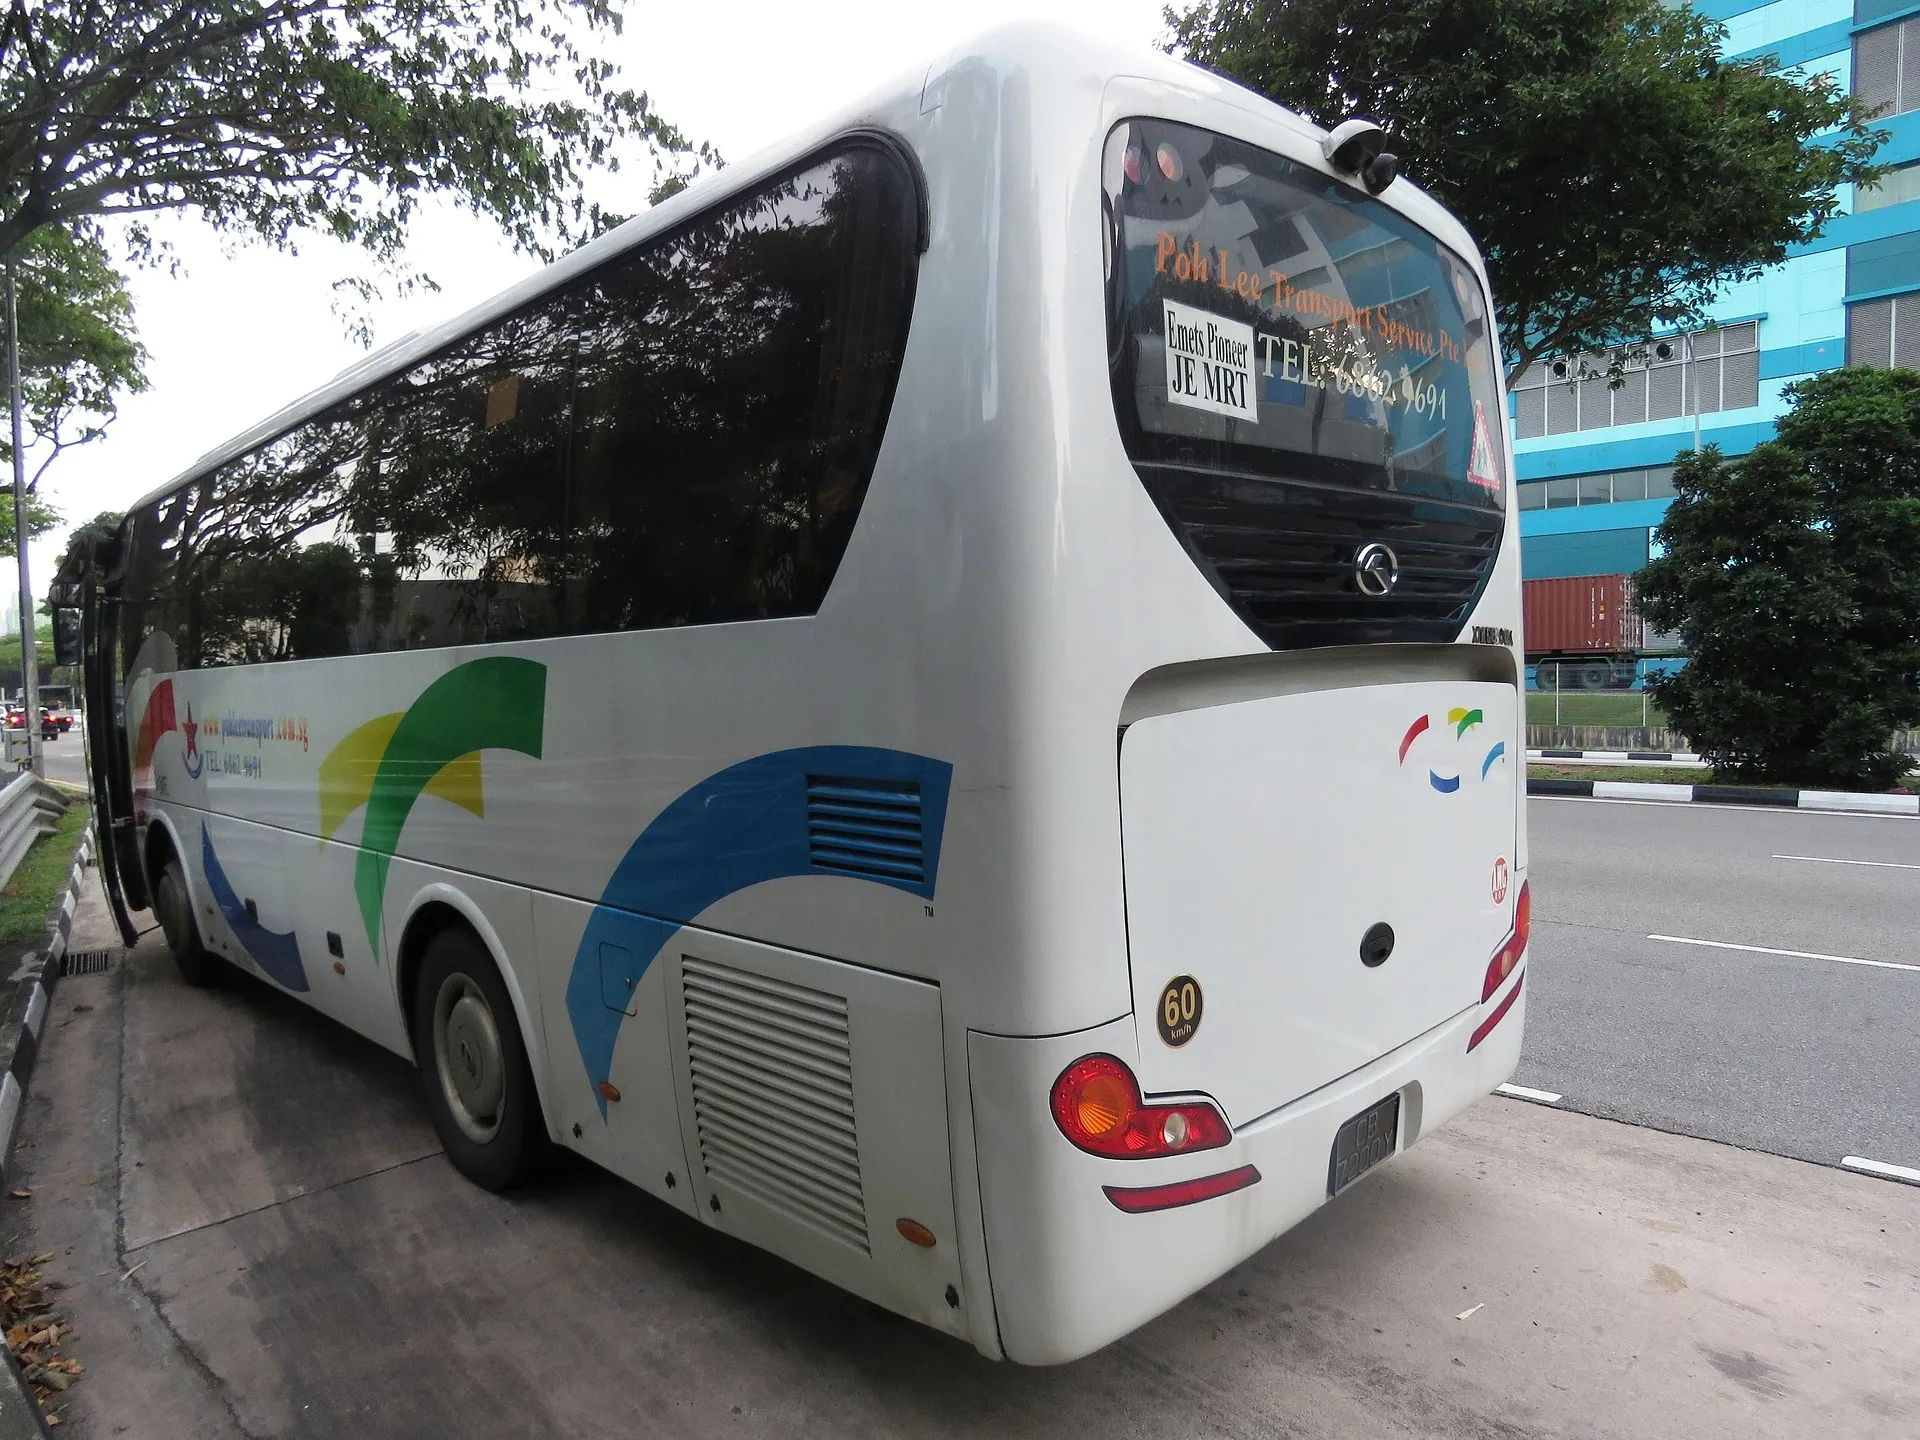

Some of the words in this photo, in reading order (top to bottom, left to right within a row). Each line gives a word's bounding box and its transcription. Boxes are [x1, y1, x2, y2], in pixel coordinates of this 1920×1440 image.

[1156, 232, 1209, 282] Poh
[1217, 250, 1263, 300] Lee
[1269, 268, 1372, 332] Transport
[1378, 304, 1434, 356] Service
[1167, 310, 1204, 357] Emets
[1207, 322, 1248, 369] Pioneer
[1258, 332, 1326, 390] TEL:
[1172, 354, 1198, 397] JE
[1202, 362, 1249, 409] MRT
[1164, 983, 1195, 1027] 60
[1171, 1024, 1192, 1040] km/h
